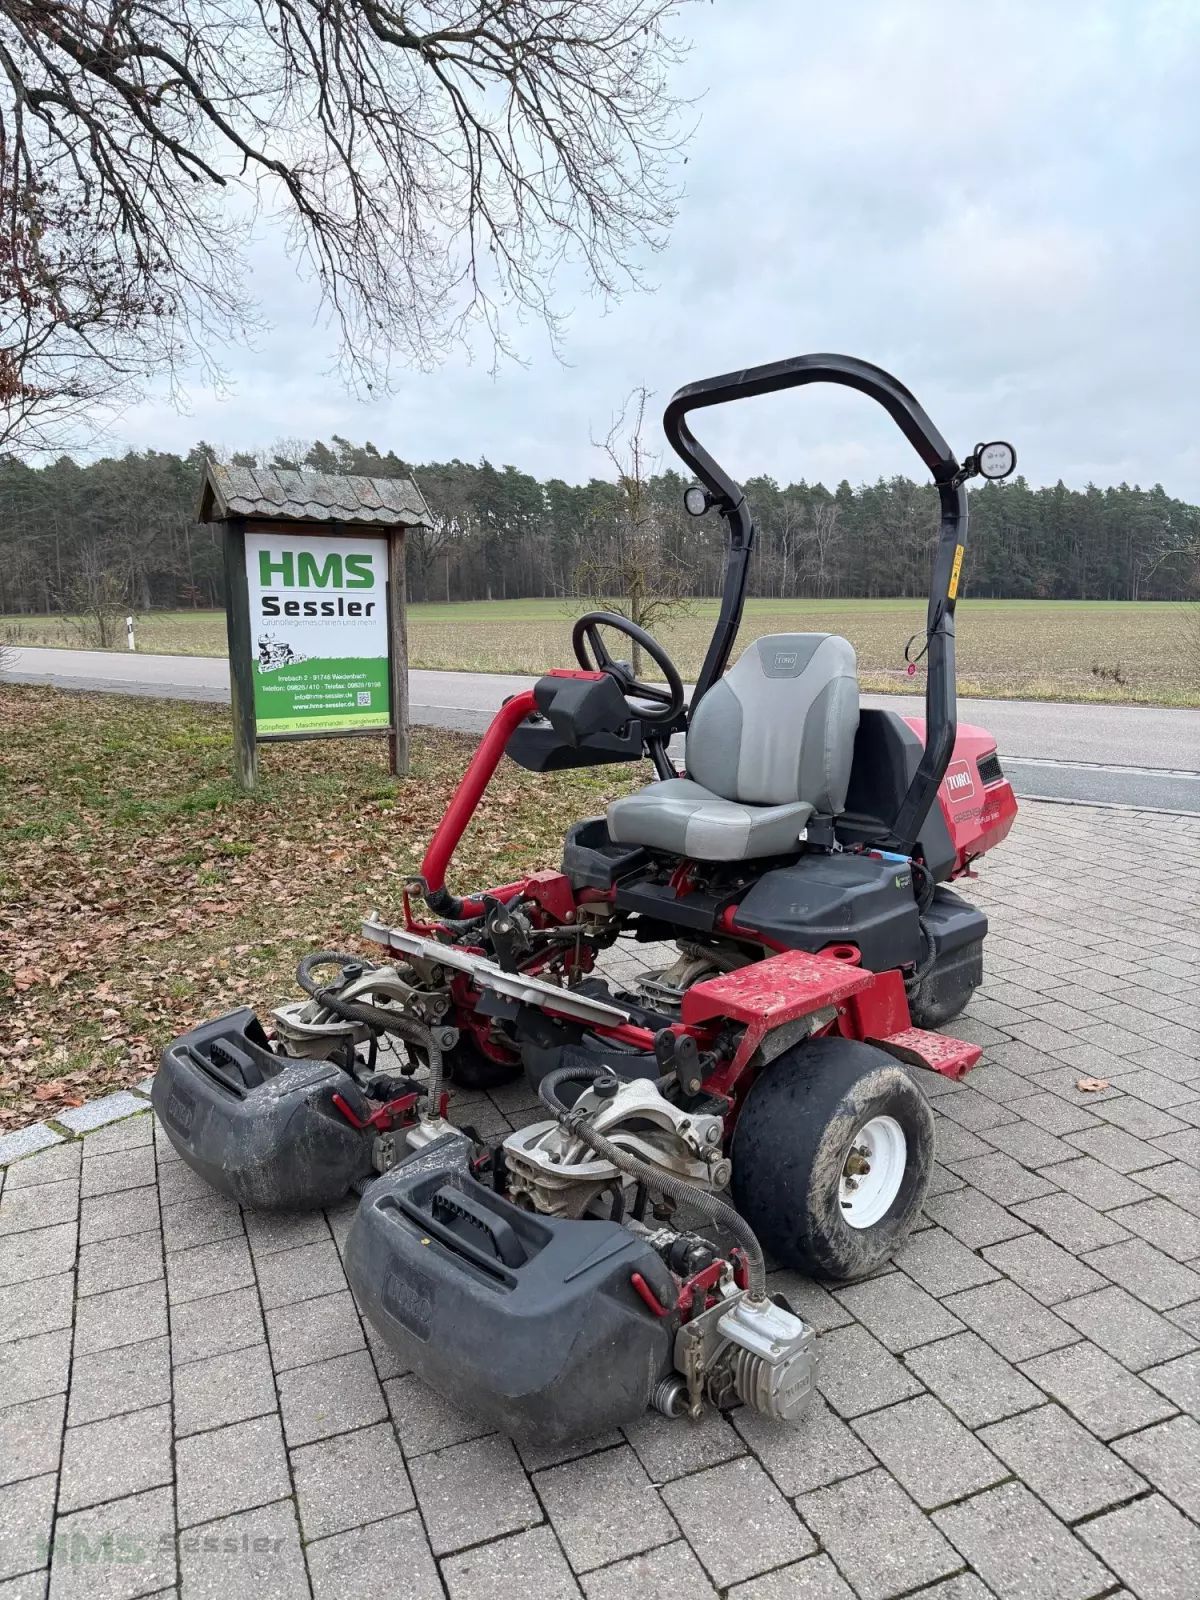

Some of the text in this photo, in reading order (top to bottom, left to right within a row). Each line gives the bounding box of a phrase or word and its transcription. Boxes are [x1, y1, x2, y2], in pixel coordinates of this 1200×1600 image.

[259, 550, 375, 589] HMS
[261, 596, 376, 617] Sessler
[292, 701, 356, 710] www.hms-sessler.de
[946, 771, 970, 791] TORO
